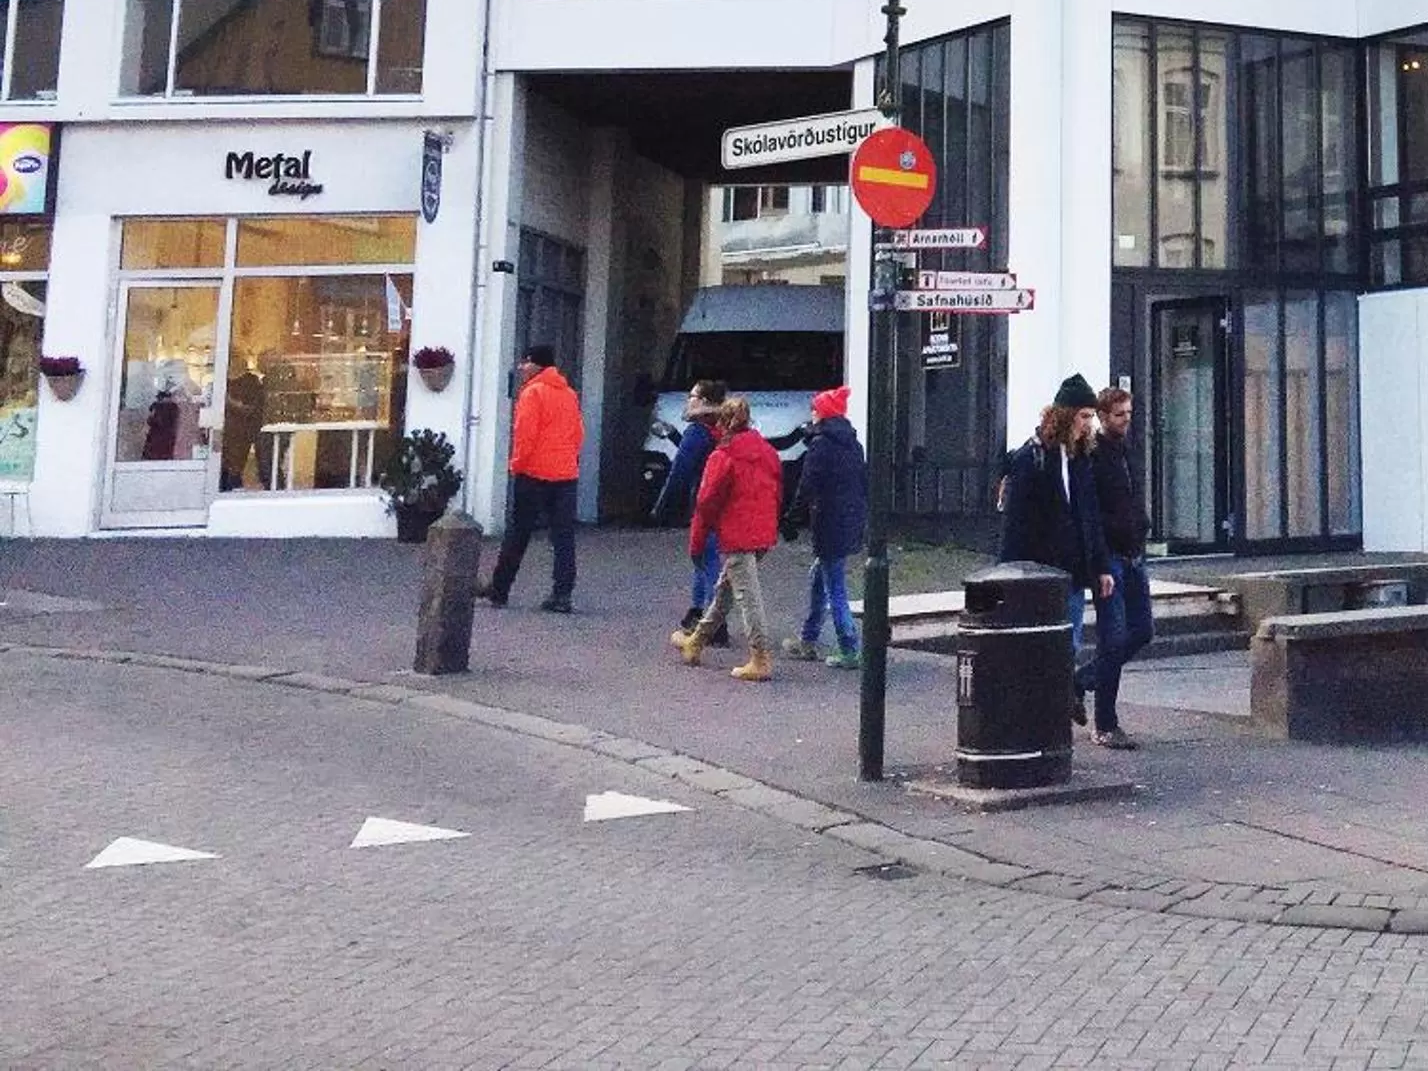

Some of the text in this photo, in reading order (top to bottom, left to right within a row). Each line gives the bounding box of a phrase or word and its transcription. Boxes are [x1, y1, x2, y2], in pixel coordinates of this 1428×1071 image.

[731, 120, 877, 157] Skólavörðustígur
[225, 149, 311, 180] Metal
[267, 179, 323, 200] design
[912, 231, 964, 244] Arnarhóll
[916, 292, 994, 307] Safnahúsið
